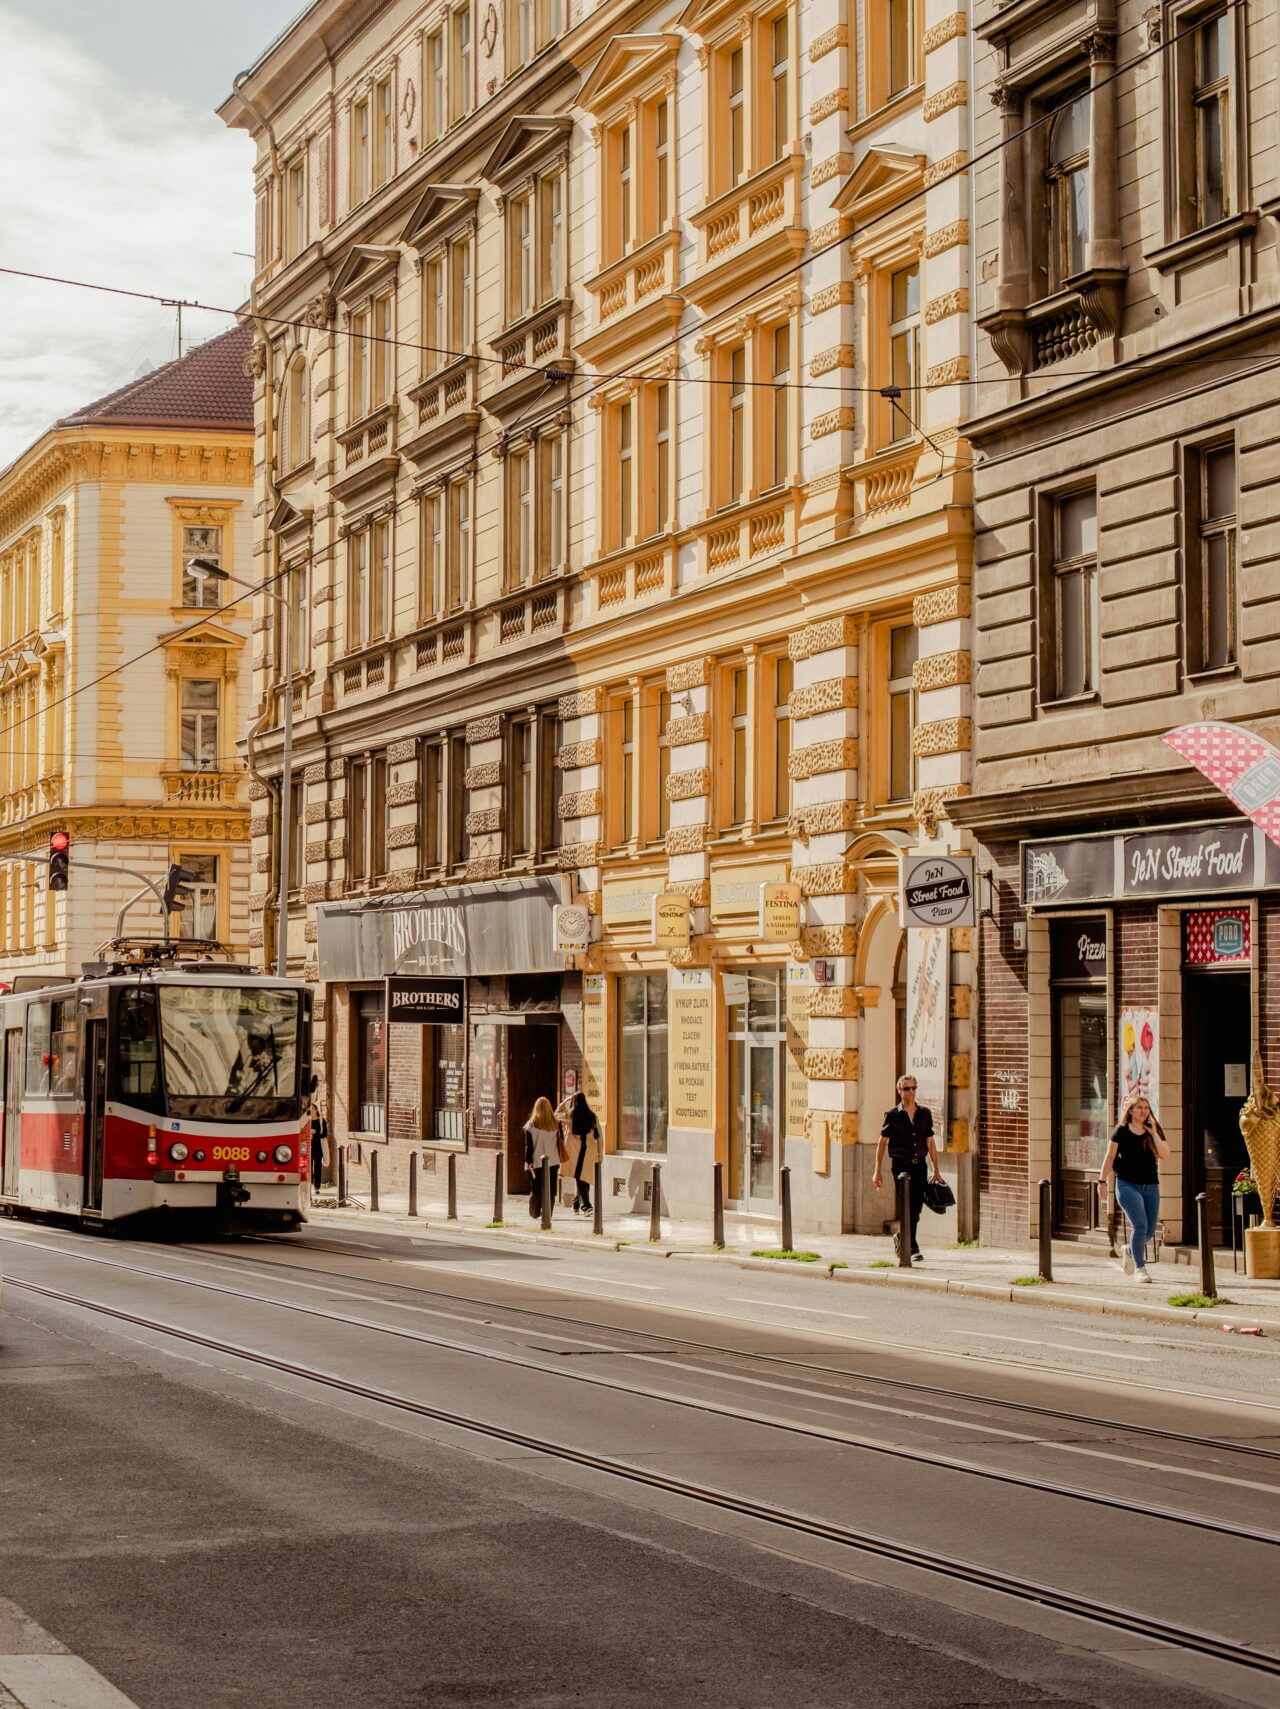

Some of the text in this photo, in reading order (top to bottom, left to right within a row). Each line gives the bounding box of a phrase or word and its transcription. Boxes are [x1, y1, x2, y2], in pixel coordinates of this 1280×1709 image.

[1161, 844, 1204, 880] Street
[1205, 832, 1249, 876] Food
[910, 880, 965, 904] Street Food
[931, 907, 952, 917] Pizza
[393, 905, 466, 961] BROTHERS
[1219, 925, 1238, 941] PURO
[1077, 934, 1105, 961] Pizza
[790, 968, 809, 980] TOPA
[392, 992, 460, 1009] BROTHERS
[912, 1057, 938, 1069] KLADNO
[213, 1146, 250, 1161] 9088
